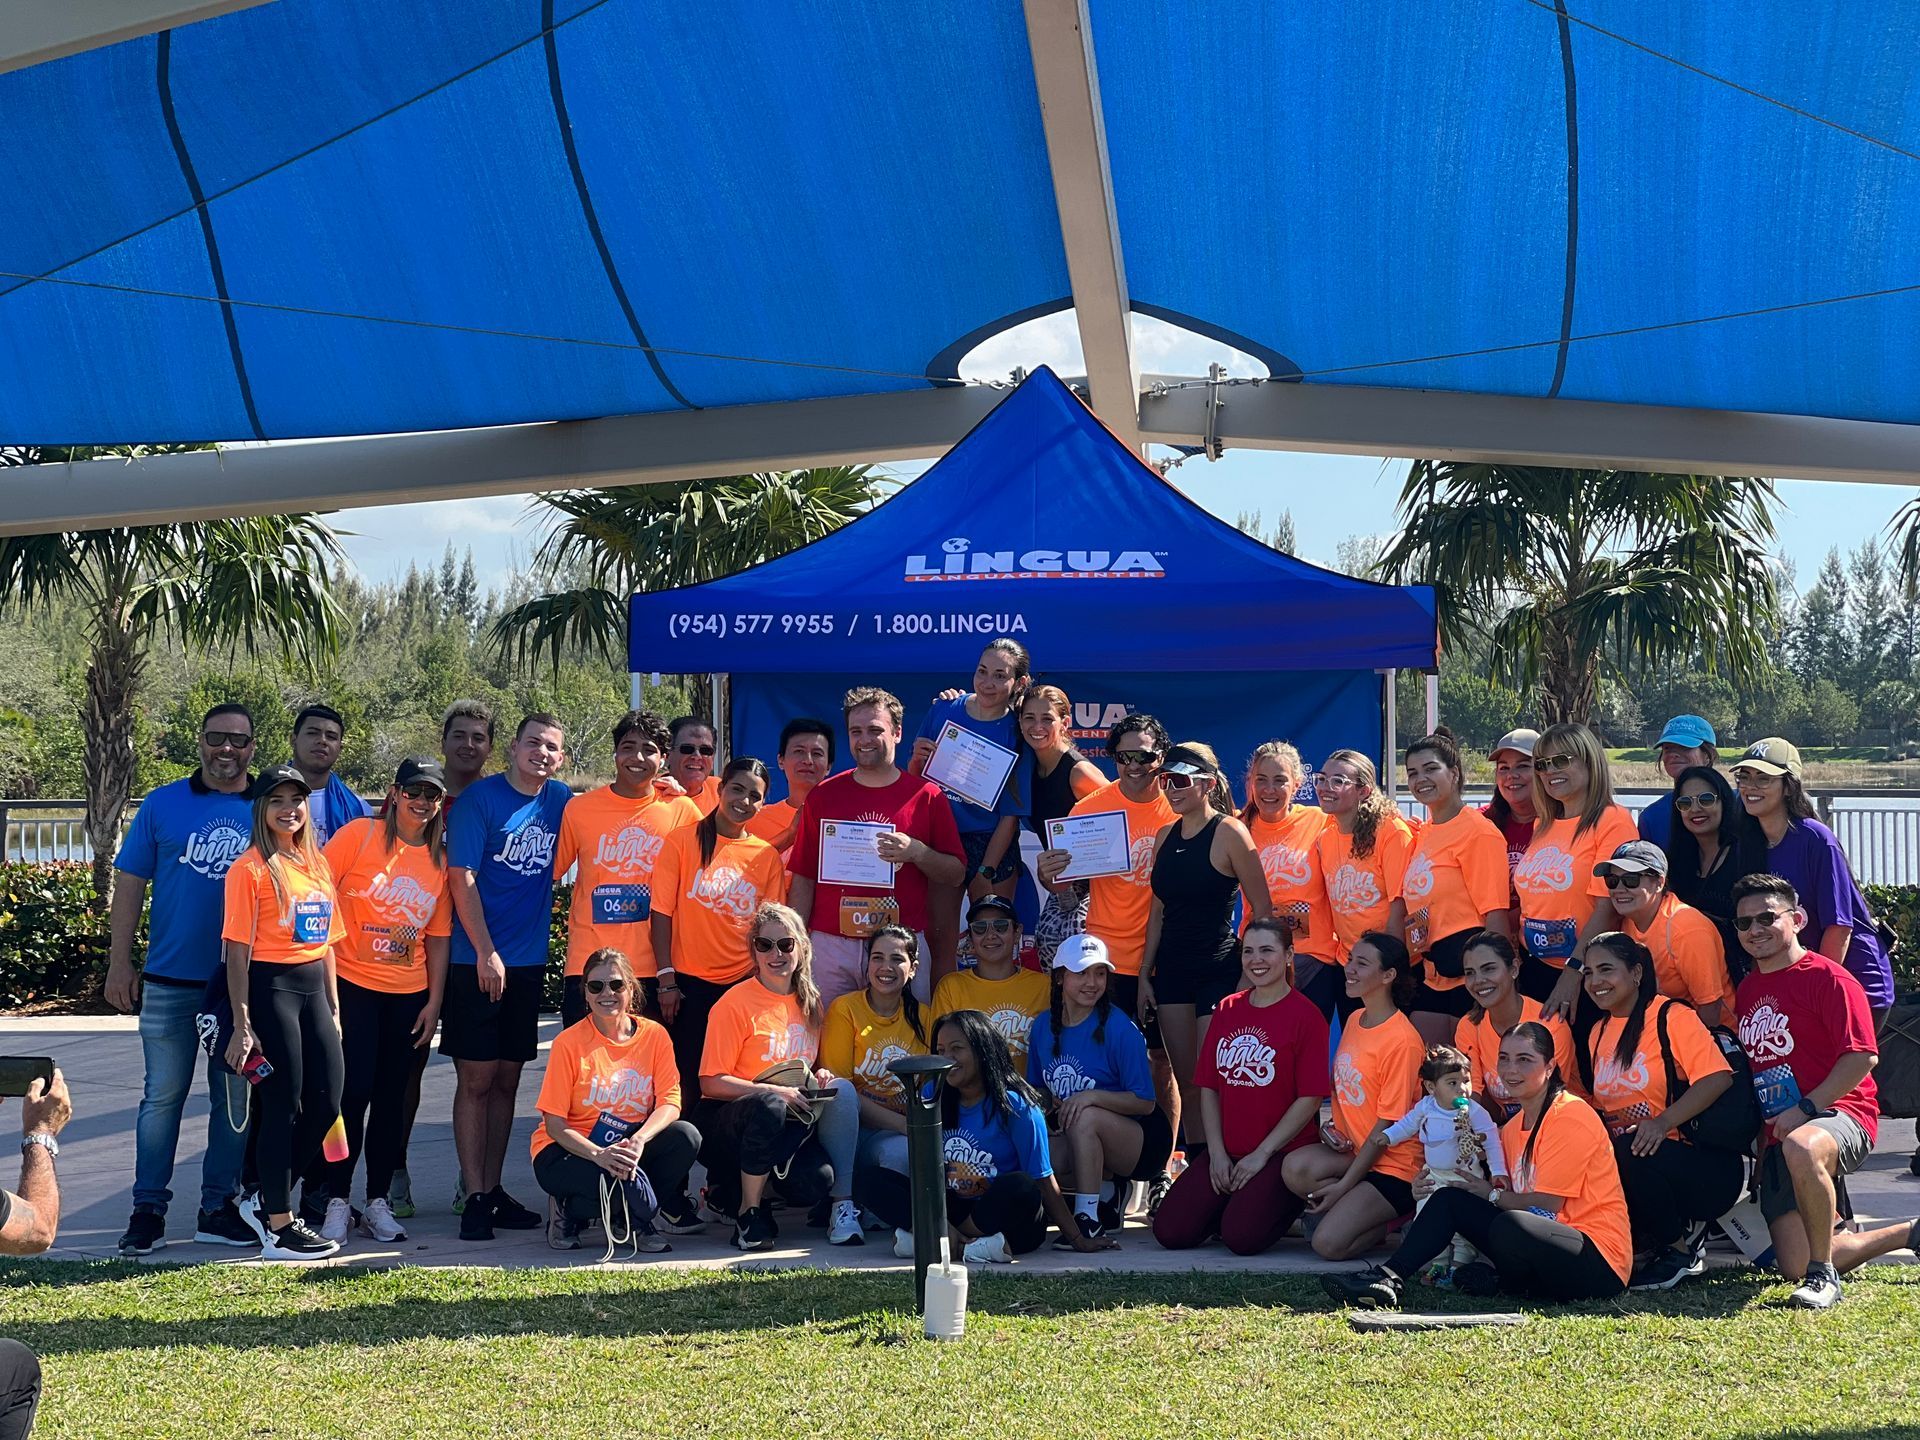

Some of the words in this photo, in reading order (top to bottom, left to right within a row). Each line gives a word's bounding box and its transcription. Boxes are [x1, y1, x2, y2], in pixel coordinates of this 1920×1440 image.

[914, 572, 1046, 581] LANGUAGE
[669, 613, 726, 638] (954)
[733, 614, 773, 634] 577
[781, 614, 834, 634] 9955
[847, 614, 859, 636] /
[873, 613, 1028, 634] 1.800.LINGUA
[1069, 702, 1128, 728] UA
[603, 899, 638, 912] 0666
[853, 911, 886, 925] 0407
[372, 937, 406, 954] 0286
